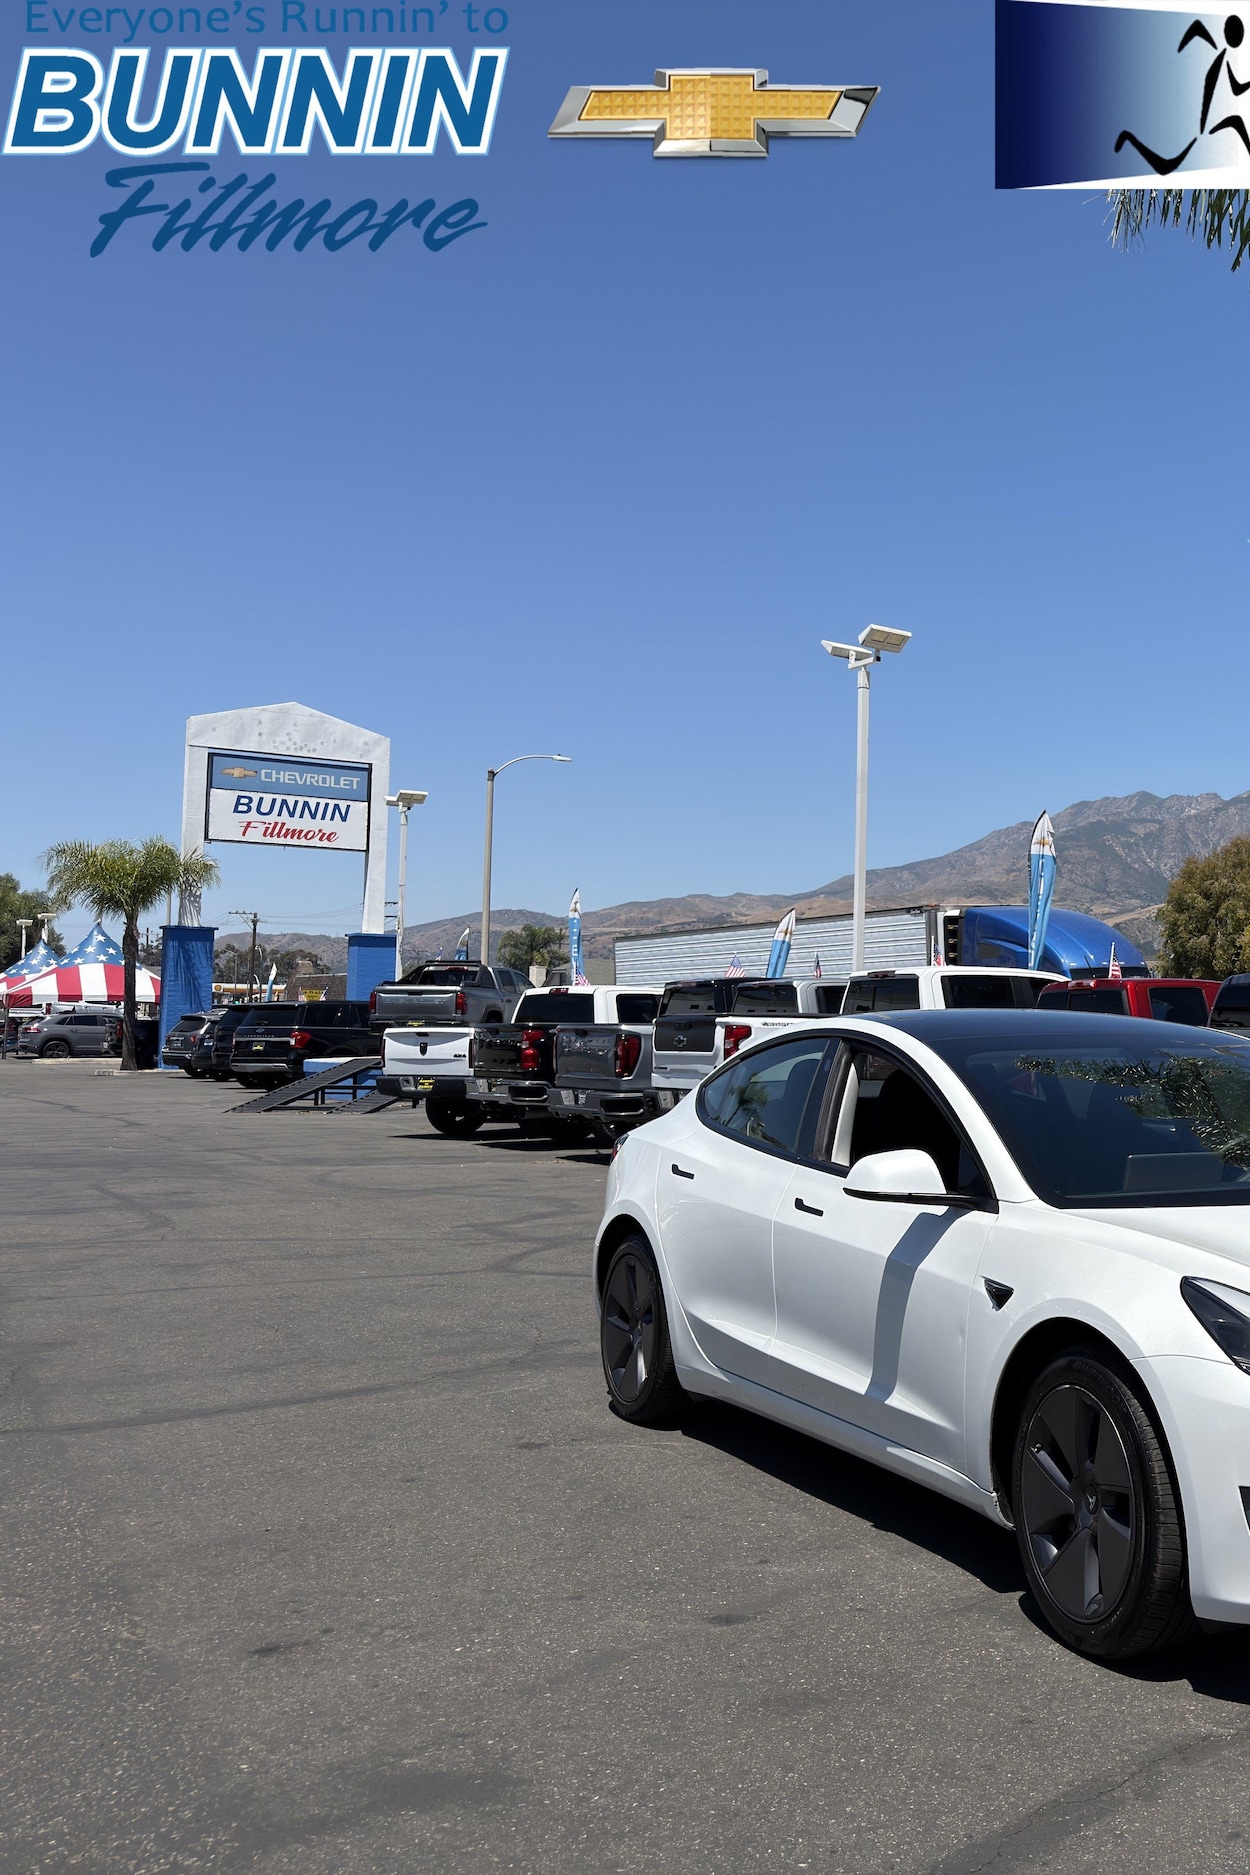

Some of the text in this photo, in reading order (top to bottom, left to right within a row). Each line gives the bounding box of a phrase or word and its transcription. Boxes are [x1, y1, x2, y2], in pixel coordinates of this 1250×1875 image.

[260, 769, 360, 789] CHEVROLET
[233, 795, 351, 822] BUNNIN
[239, 820, 339, 843] Fillmore
